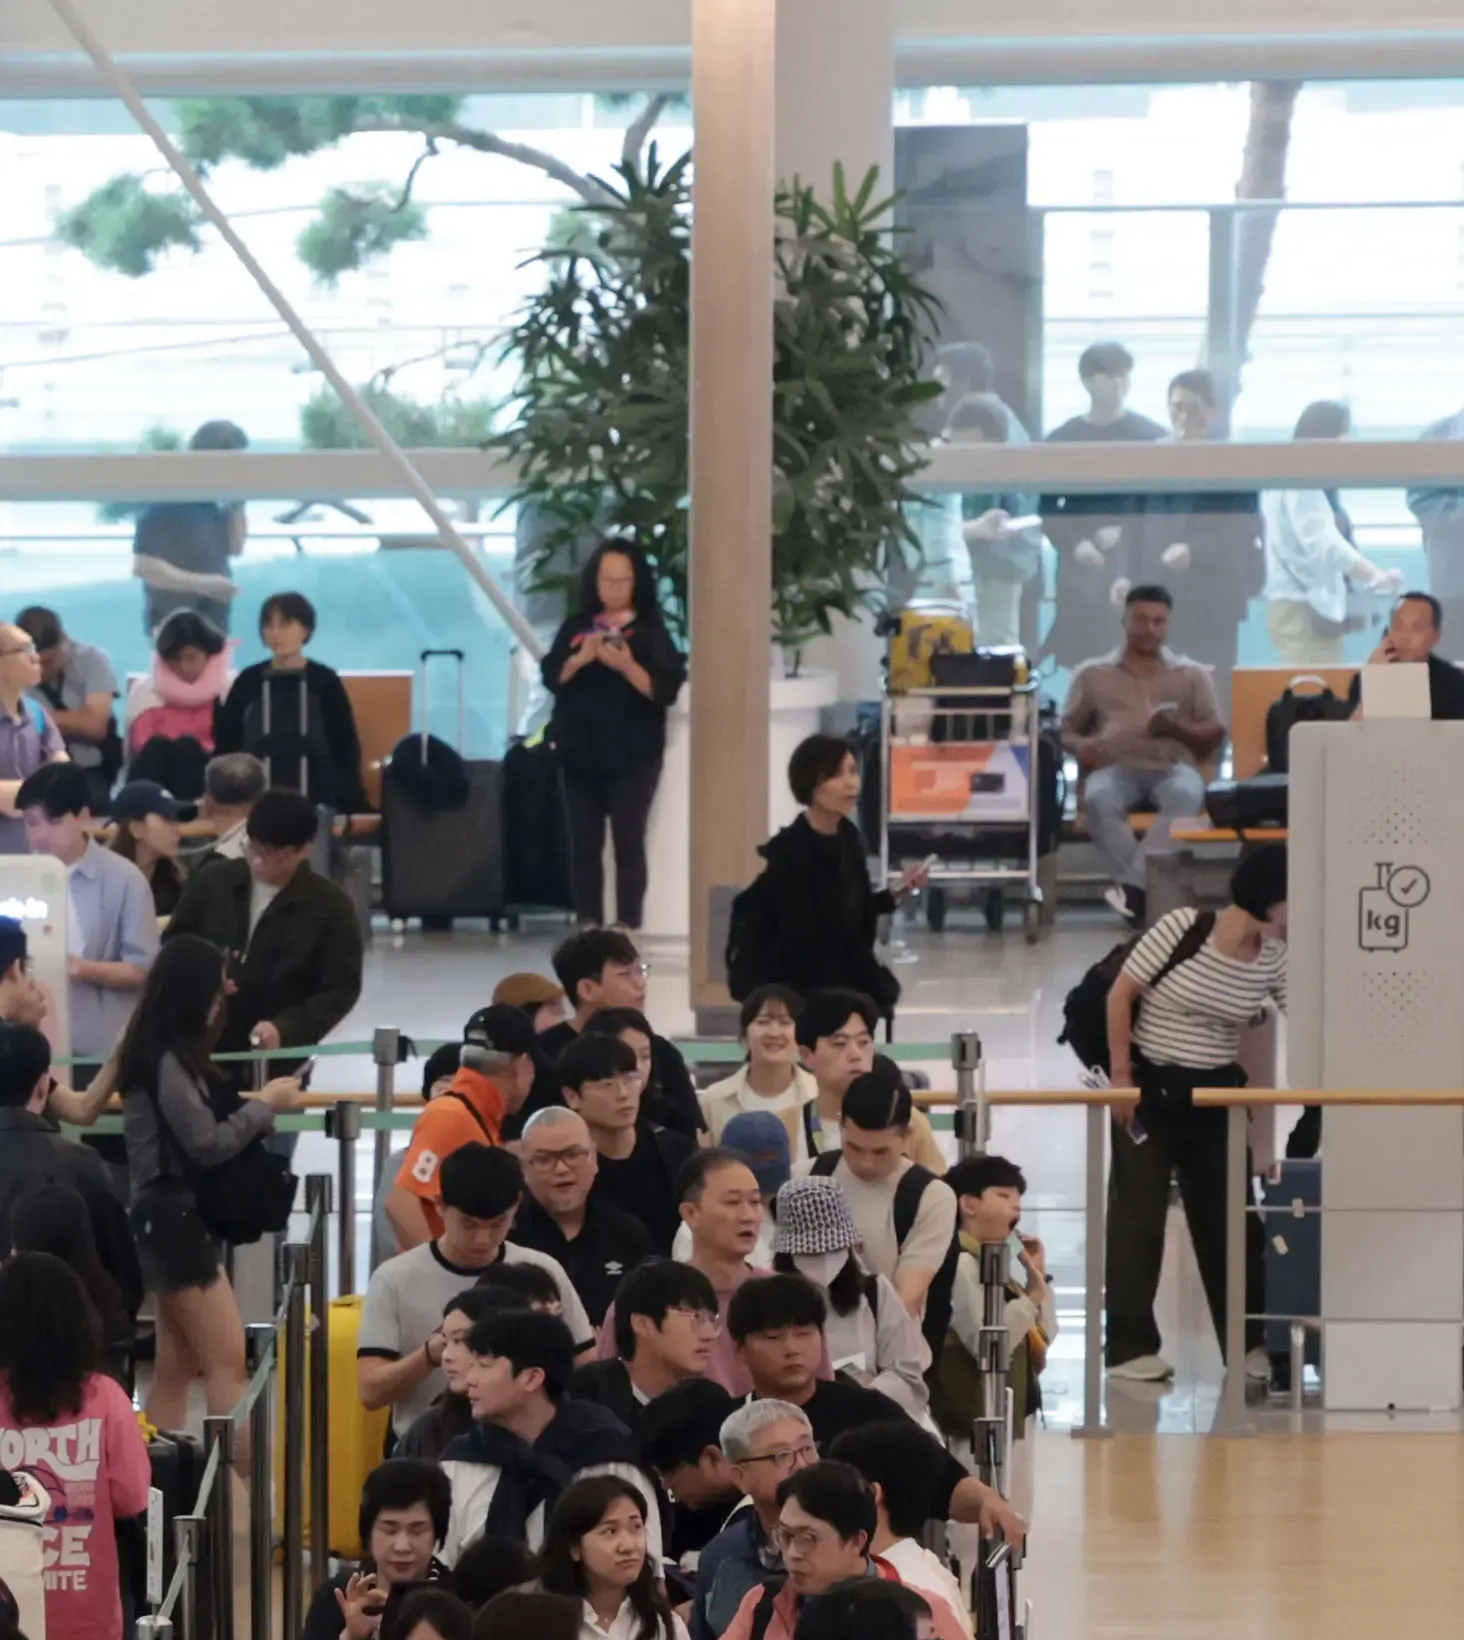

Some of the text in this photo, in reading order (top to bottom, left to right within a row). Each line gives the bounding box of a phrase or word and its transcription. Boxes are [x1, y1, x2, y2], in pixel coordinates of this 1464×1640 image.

[1366, 910, 1400, 937] kg
[412, 1149, 439, 1183] 8
[42, 1525, 93, 1566] CE
